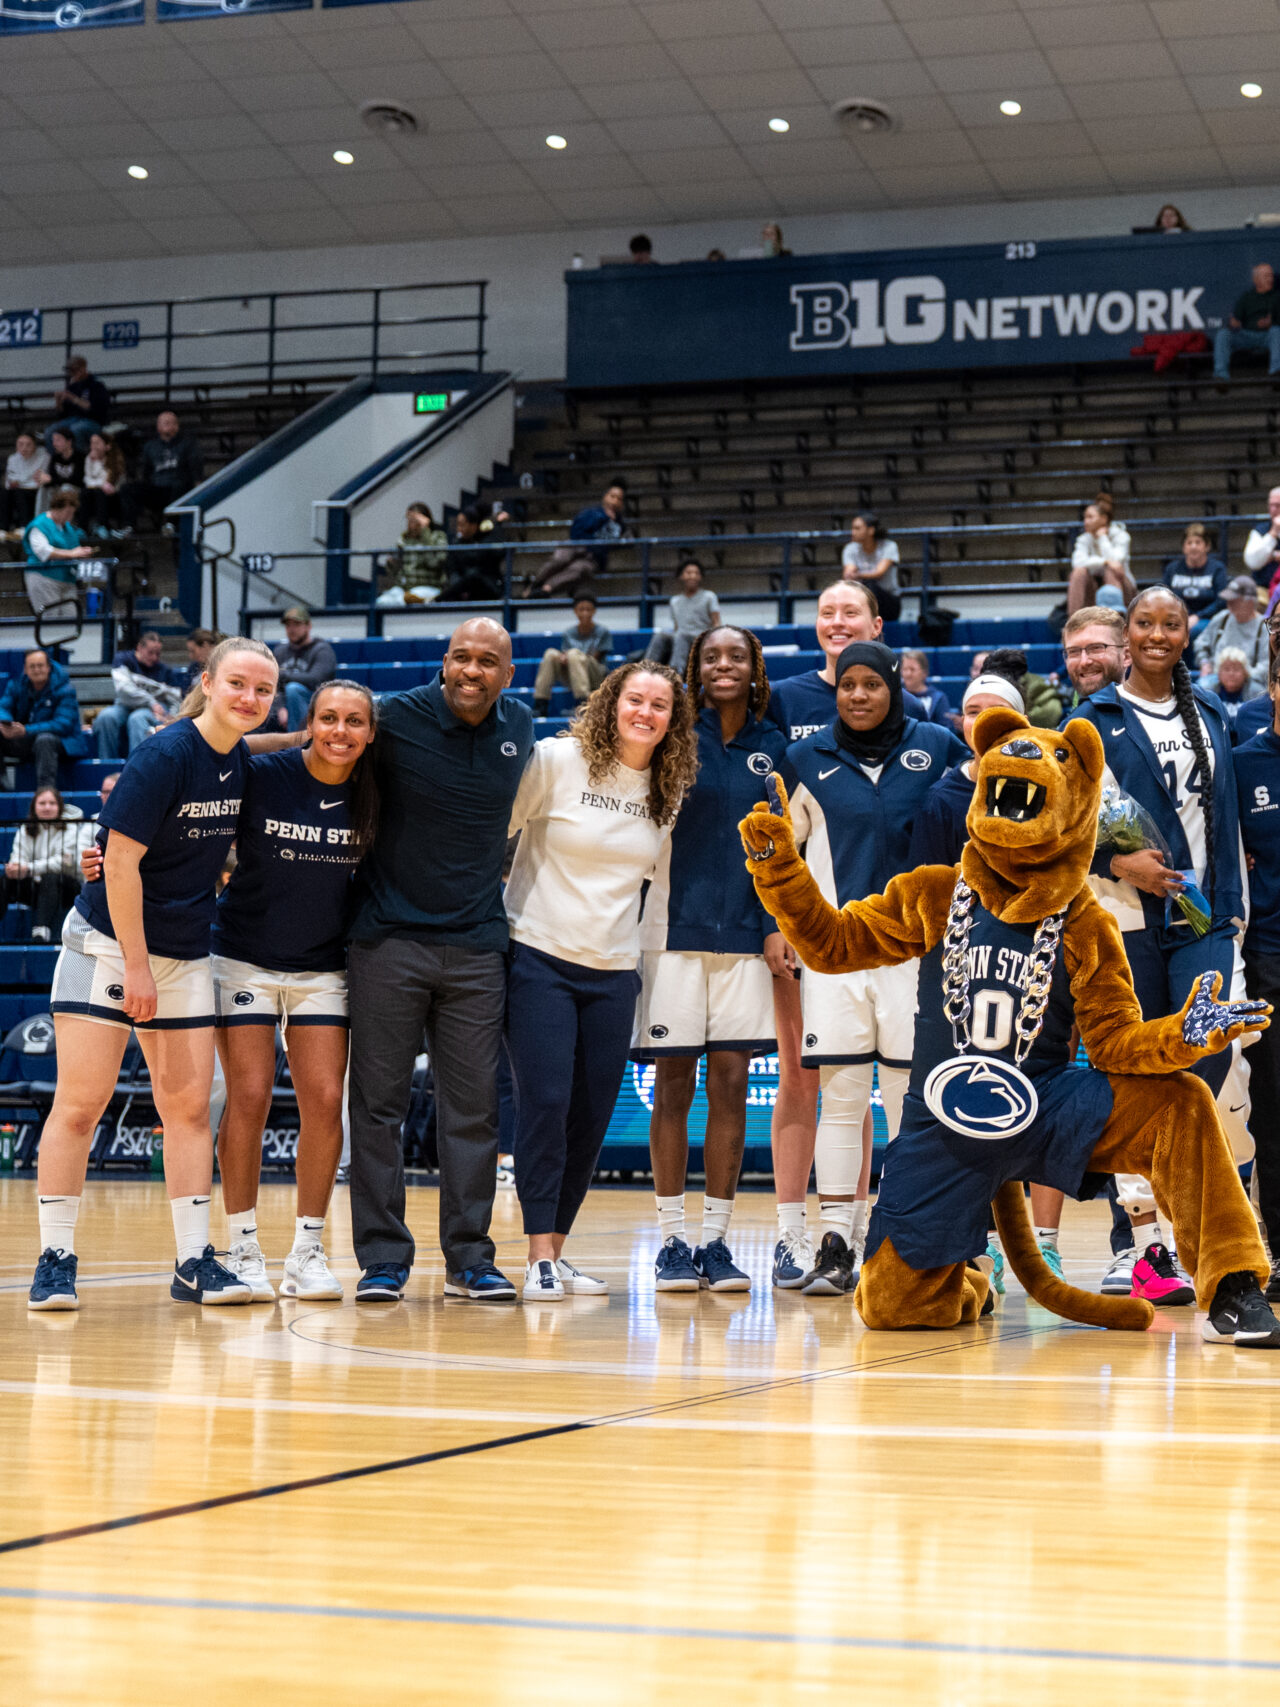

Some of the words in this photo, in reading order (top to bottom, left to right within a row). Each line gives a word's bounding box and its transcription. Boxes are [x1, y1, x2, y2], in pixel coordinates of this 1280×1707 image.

[1005, 242, 1036, 260] 213
[953, 286, 1206, 342] NETWORK
[0, 317, 38, 344] 212
[580, 792, 622, 812] PENN
[624, 801, 655, 820] STAT
[1254, 785, 1270, 807] S
[177, 801, 221, 818] PENN
[264, 818, 322, 843] PENN
[995, 947, 1031, 992] STA
